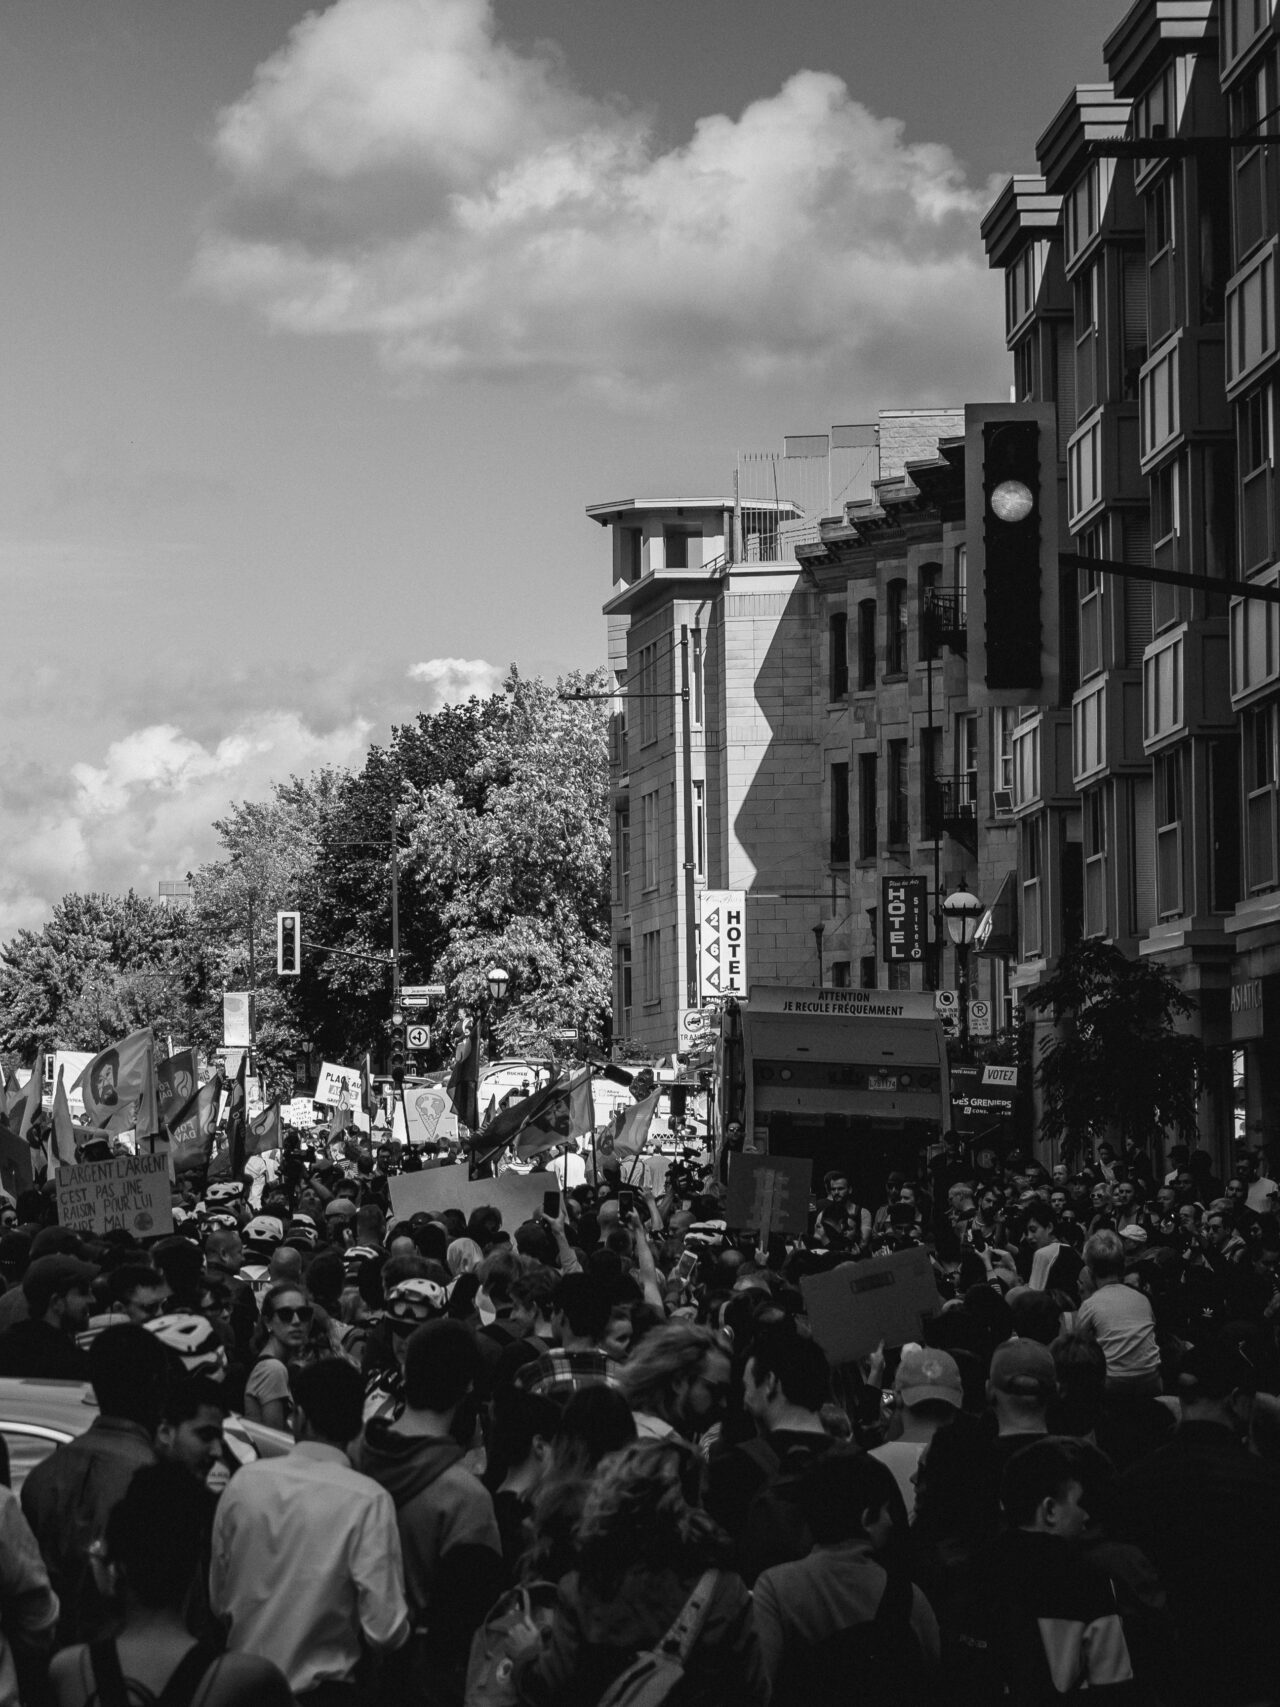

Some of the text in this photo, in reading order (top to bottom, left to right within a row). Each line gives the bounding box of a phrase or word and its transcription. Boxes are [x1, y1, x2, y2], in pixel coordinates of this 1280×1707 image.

[887, 888, 905, 957] HÔTEL
[727, 910, 741, 991] HOTEL
[818, 991, 870, 1002] ATTENTION
[783, 1001, 904, 1016] JE RECULE FRÉQUEMMENT
[987, 1069, 1014, 1081] VOTEZ
[970, 1098, 1012, 1109] GRENIERS
[59, 1154, 167, 1187] L'ARGENT L'ARGENT
[95, 1183, 115, 1200] PAS
[122, 1179, 143, 1196] UNE
[63, 1193, 153, 1221] RAISON POUR LUI
